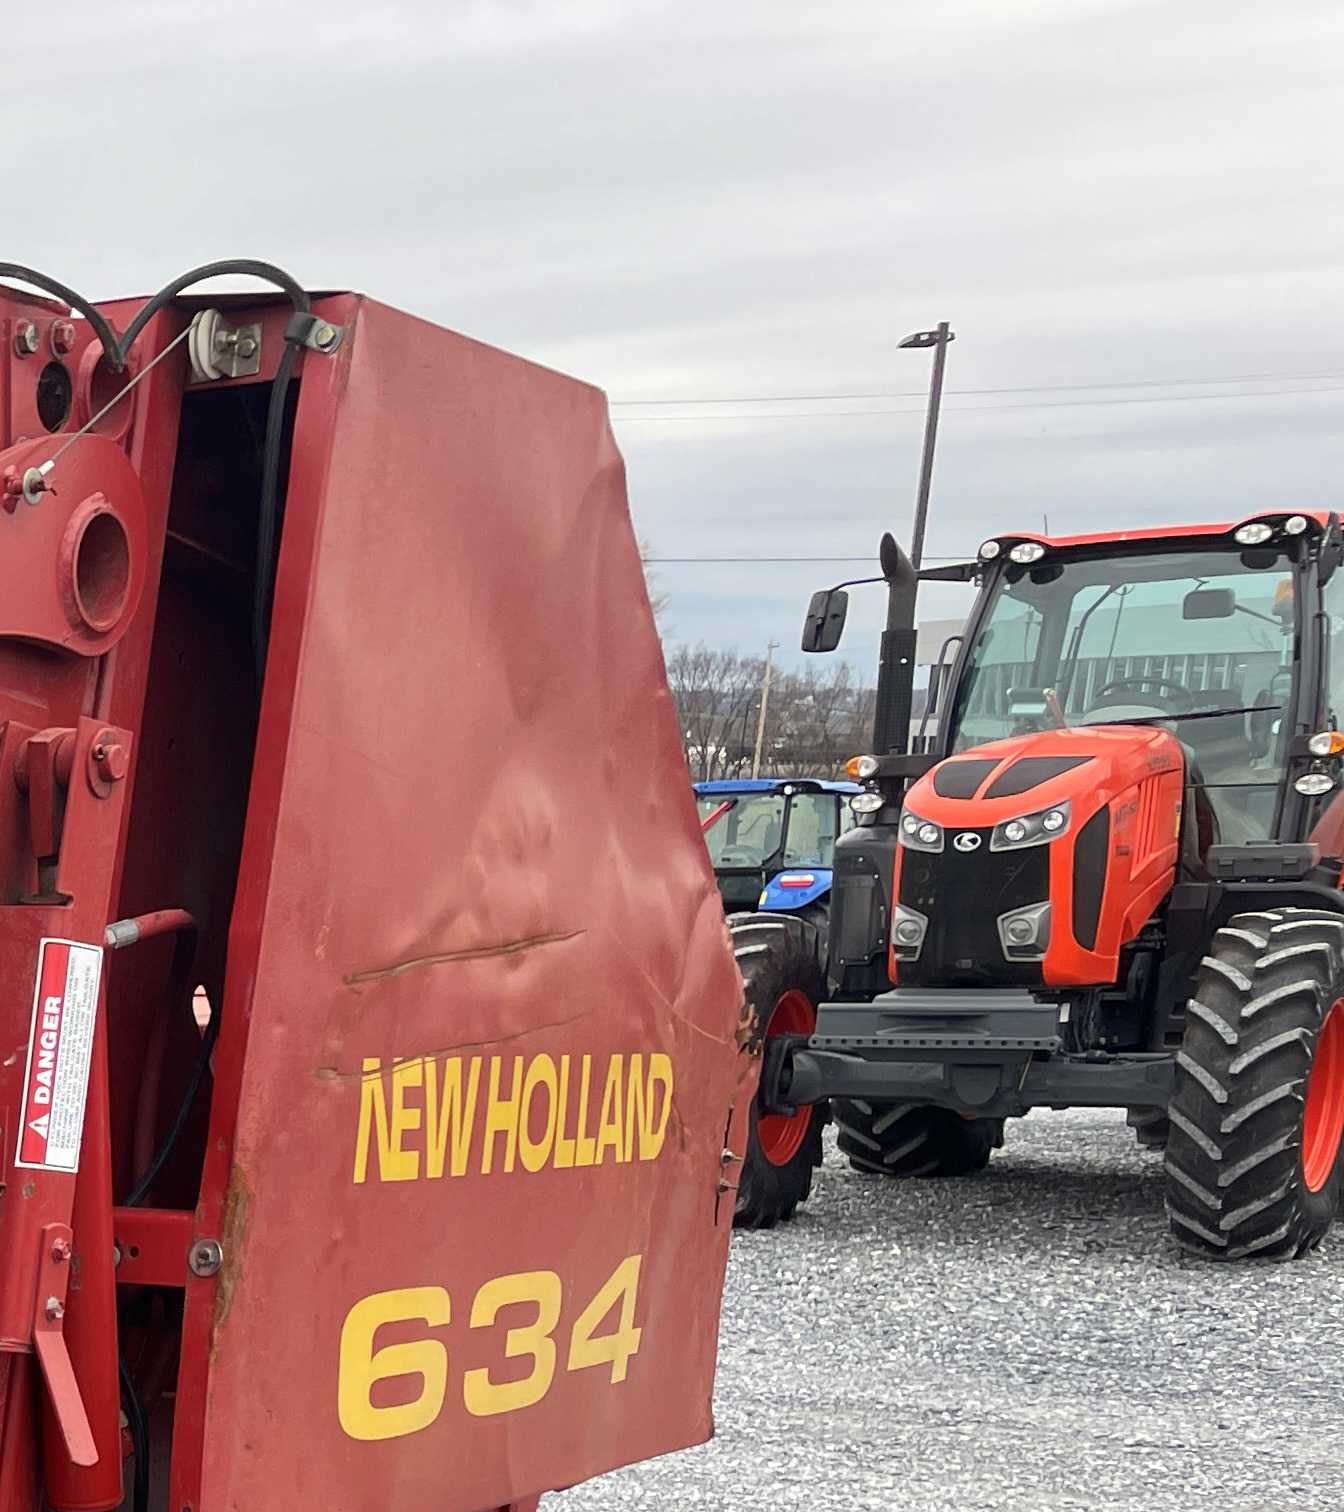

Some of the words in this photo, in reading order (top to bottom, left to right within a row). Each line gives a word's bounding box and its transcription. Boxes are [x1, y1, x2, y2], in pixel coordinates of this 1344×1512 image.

[33, 996, 62, 1105] DANGER
[353, 1056, 482, 1184] NEW
[480, 1053, 674, 1175] HOLLAND
[337, 1254, 642, 1441] 634
